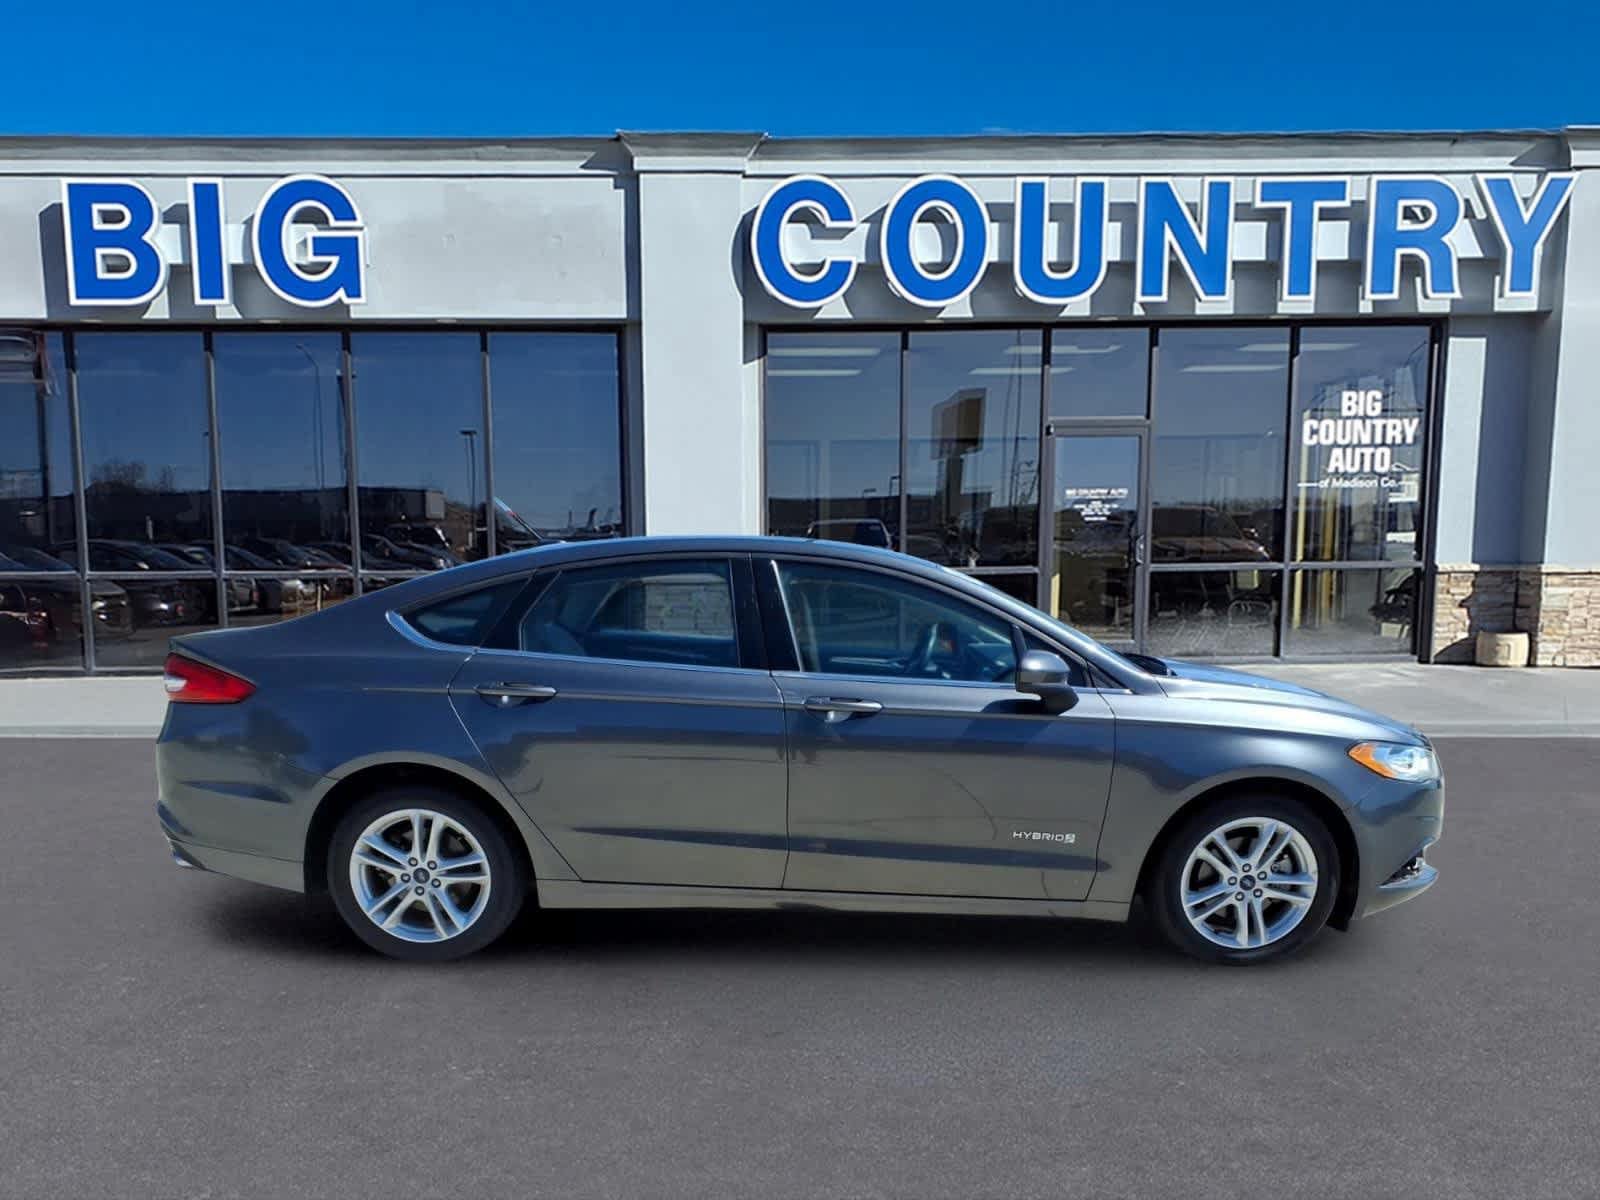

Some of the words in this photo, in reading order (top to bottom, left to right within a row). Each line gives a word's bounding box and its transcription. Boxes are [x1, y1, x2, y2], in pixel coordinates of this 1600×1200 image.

[60, 174, 367, 307] BIG
[750, 172, 1577, 308] COUNTRY
[1341, 390, 1382, 417] BIG
[1302, 418, 1420, 446] COUNTRY
[1327, 447, 1392, 473] AUTO
[1331, 477, 1378, 488] Madison
